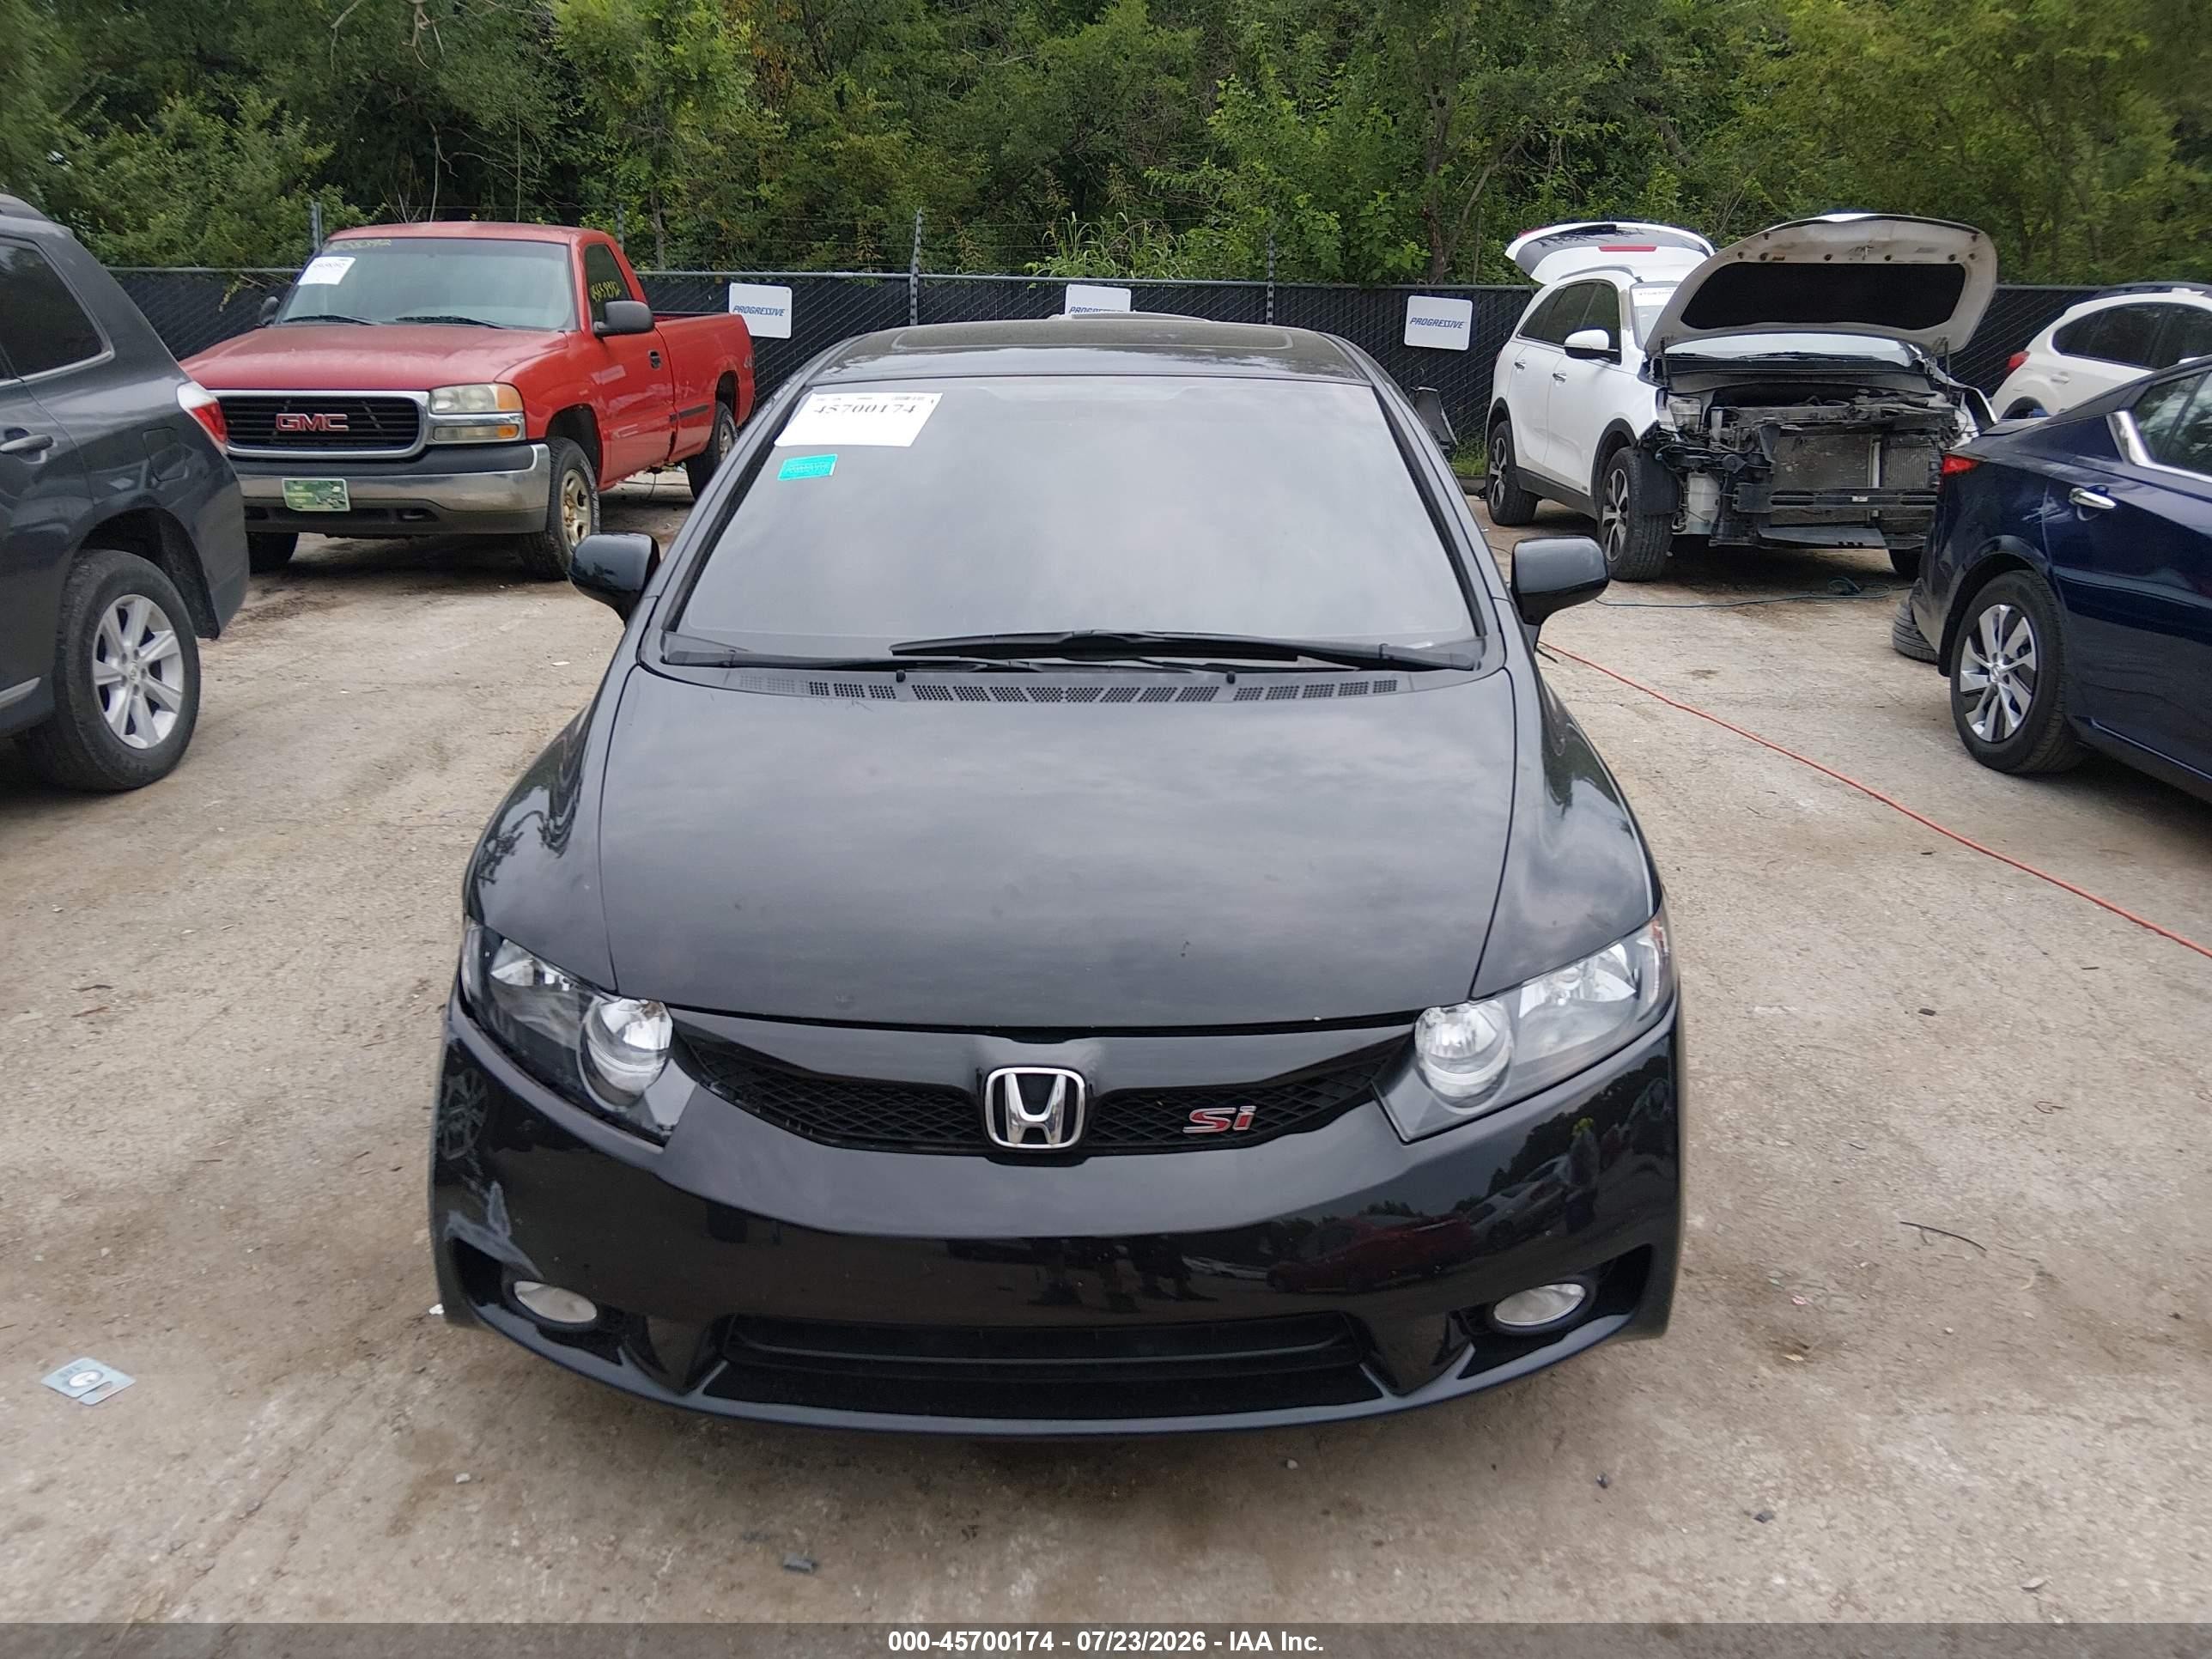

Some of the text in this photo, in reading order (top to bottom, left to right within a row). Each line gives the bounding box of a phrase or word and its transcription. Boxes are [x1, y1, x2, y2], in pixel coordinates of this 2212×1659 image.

[732, 305, 785, 316] PROGRESSIVE
[1409, 317, 1465, 329] PROGRESSIVE
[276, 413, 349, 431] GMC
[1182, 1105, 1257, 1134] Si
